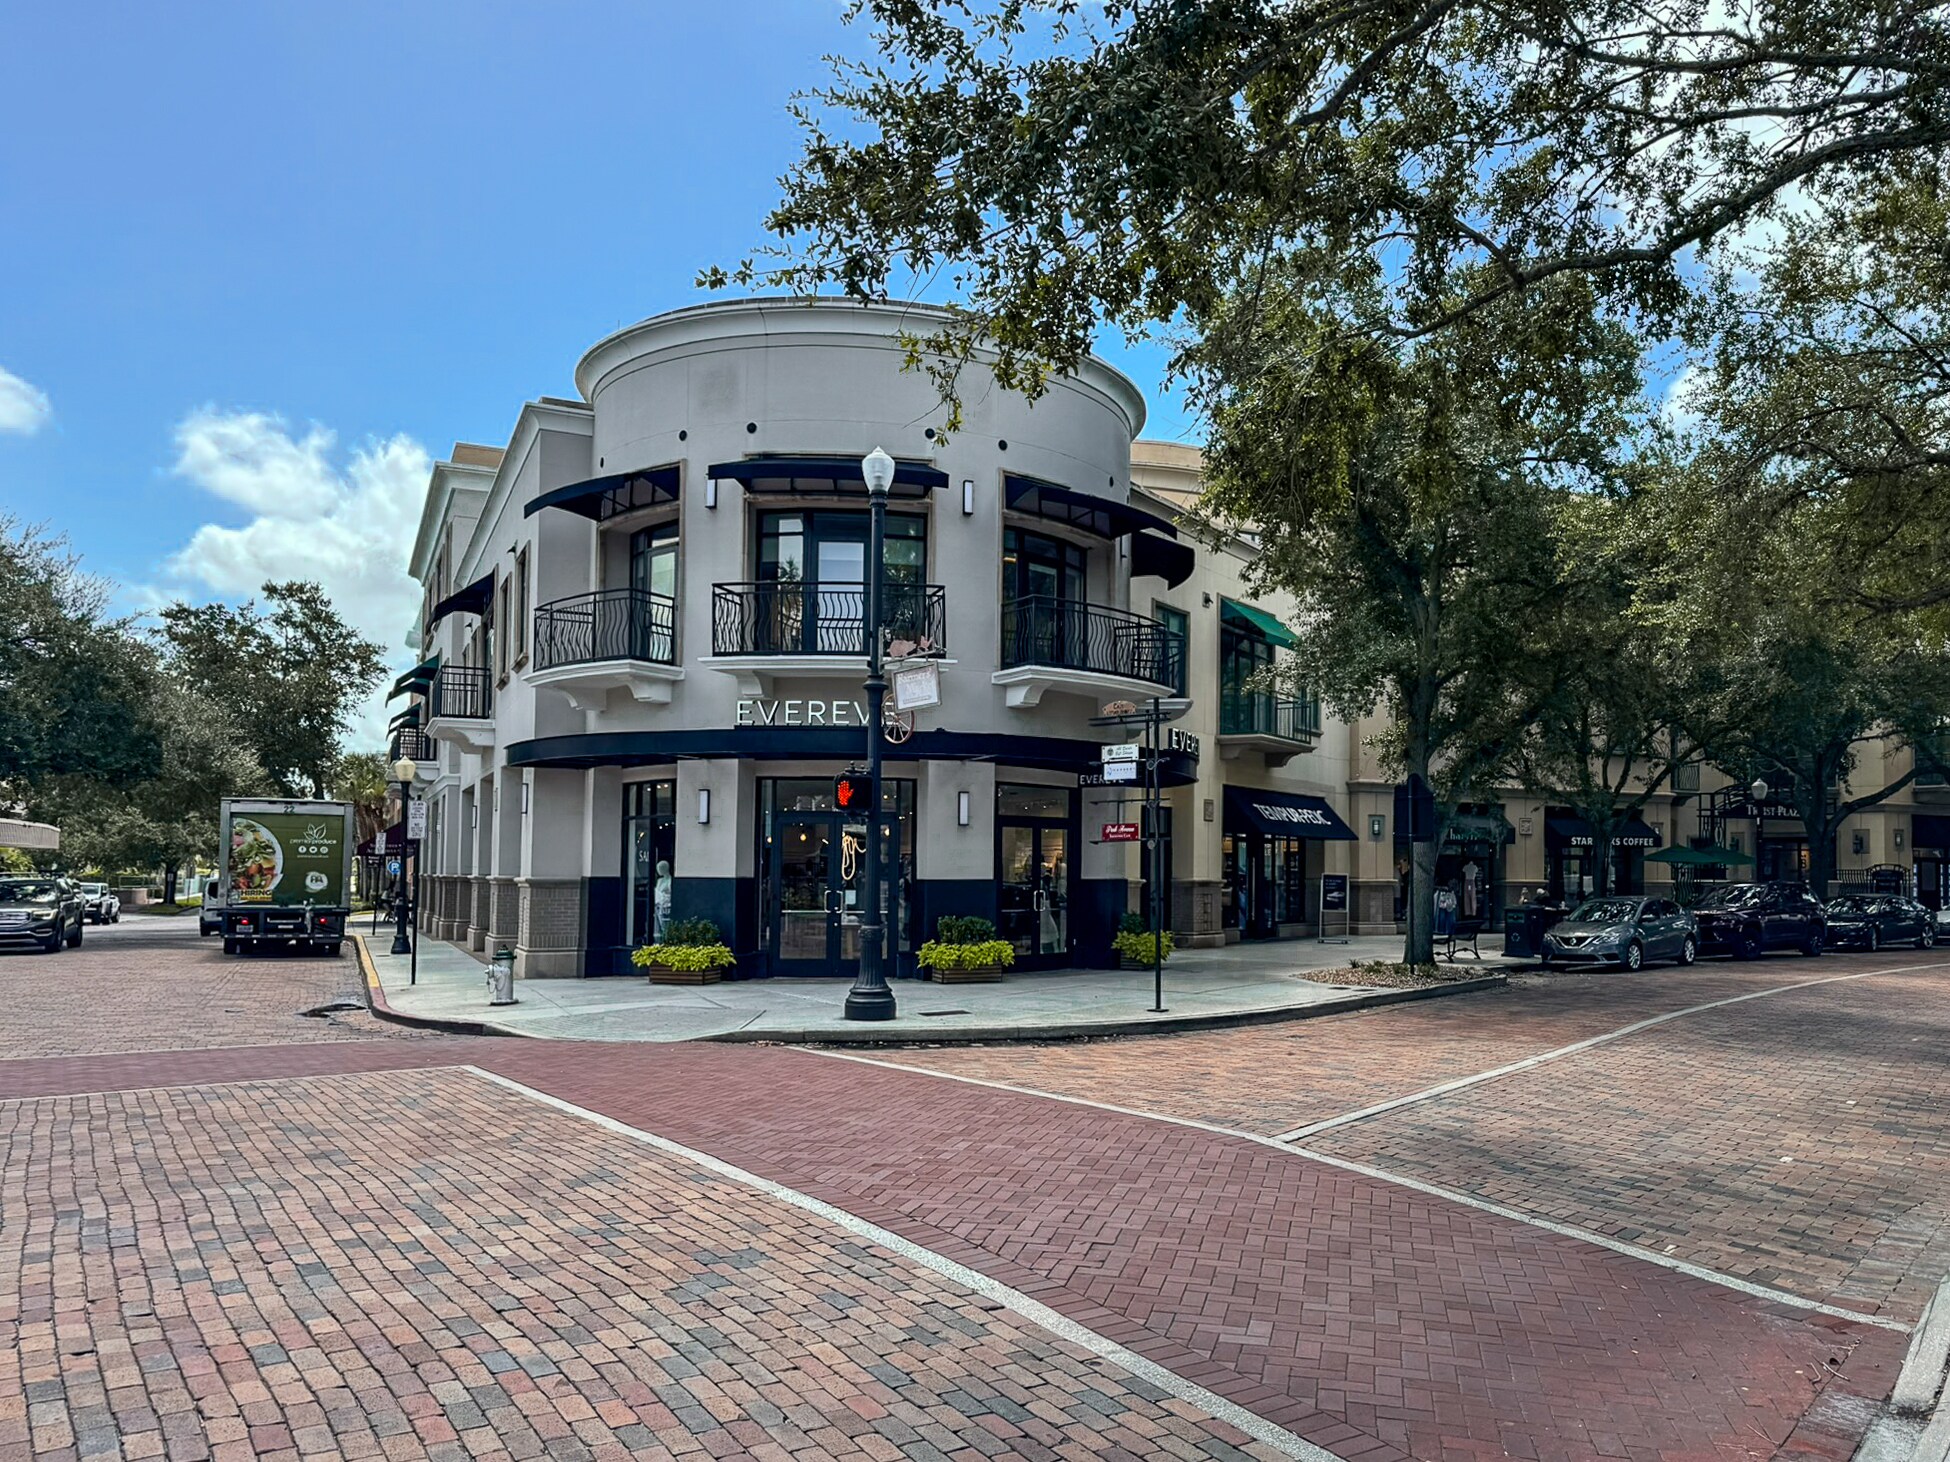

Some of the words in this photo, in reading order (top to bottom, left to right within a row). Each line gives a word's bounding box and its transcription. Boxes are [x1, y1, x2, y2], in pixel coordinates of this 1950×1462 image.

[284, 805, 295, 813] 22
[1746, 804, 1776, 816] TRIST
[1571, 836, 1621, 846] STARKS
[1623, 837, 1654, 846] COFFEE
